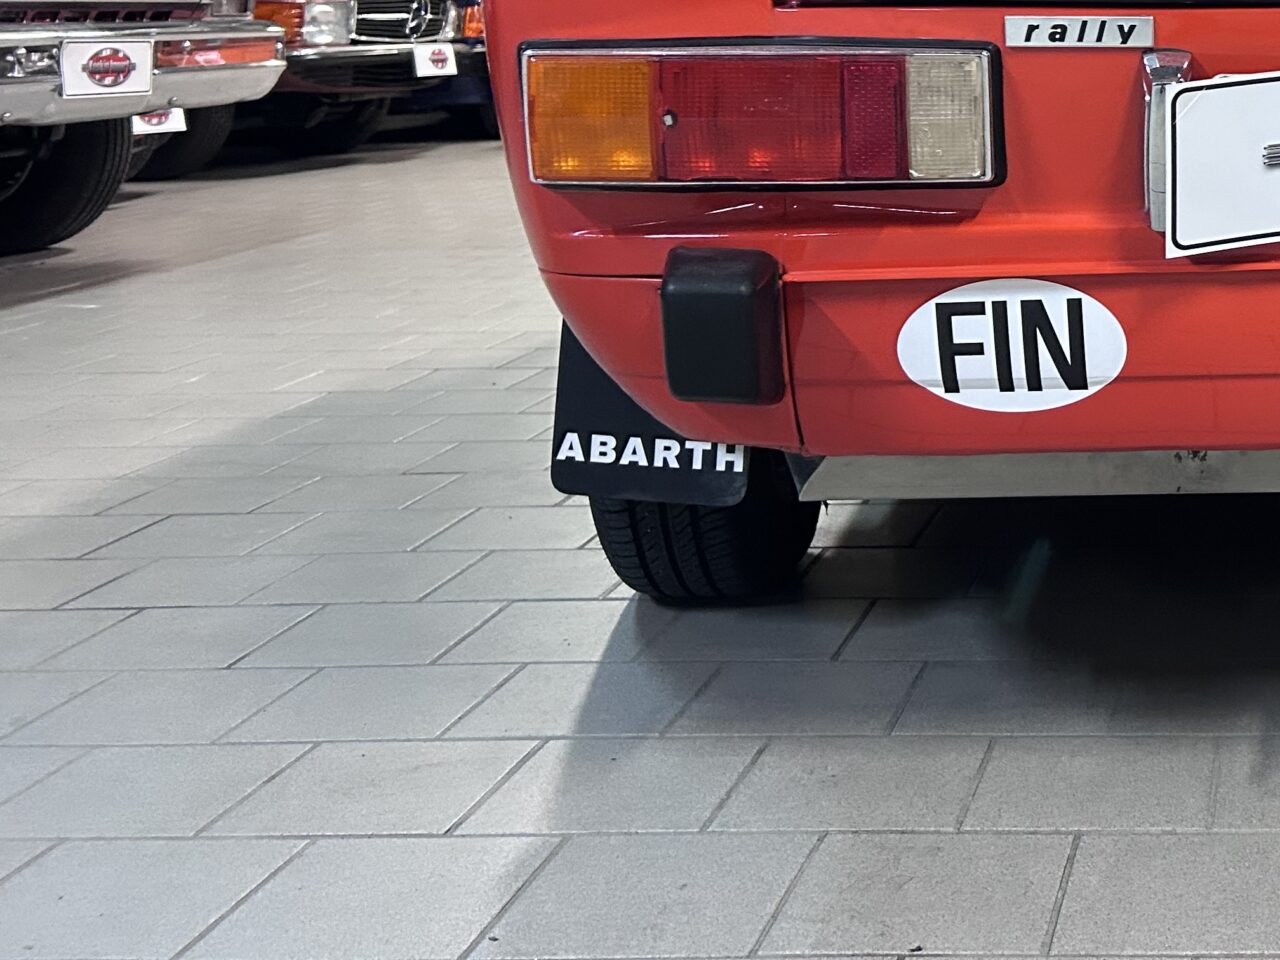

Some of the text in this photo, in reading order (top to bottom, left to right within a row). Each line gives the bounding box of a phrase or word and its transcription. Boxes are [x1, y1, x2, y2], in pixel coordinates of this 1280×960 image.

[1024, 20, 1137, 45] rally
[935, 297, 1089, 394] FIN
[556, 432, 745, 472] ABARTH
